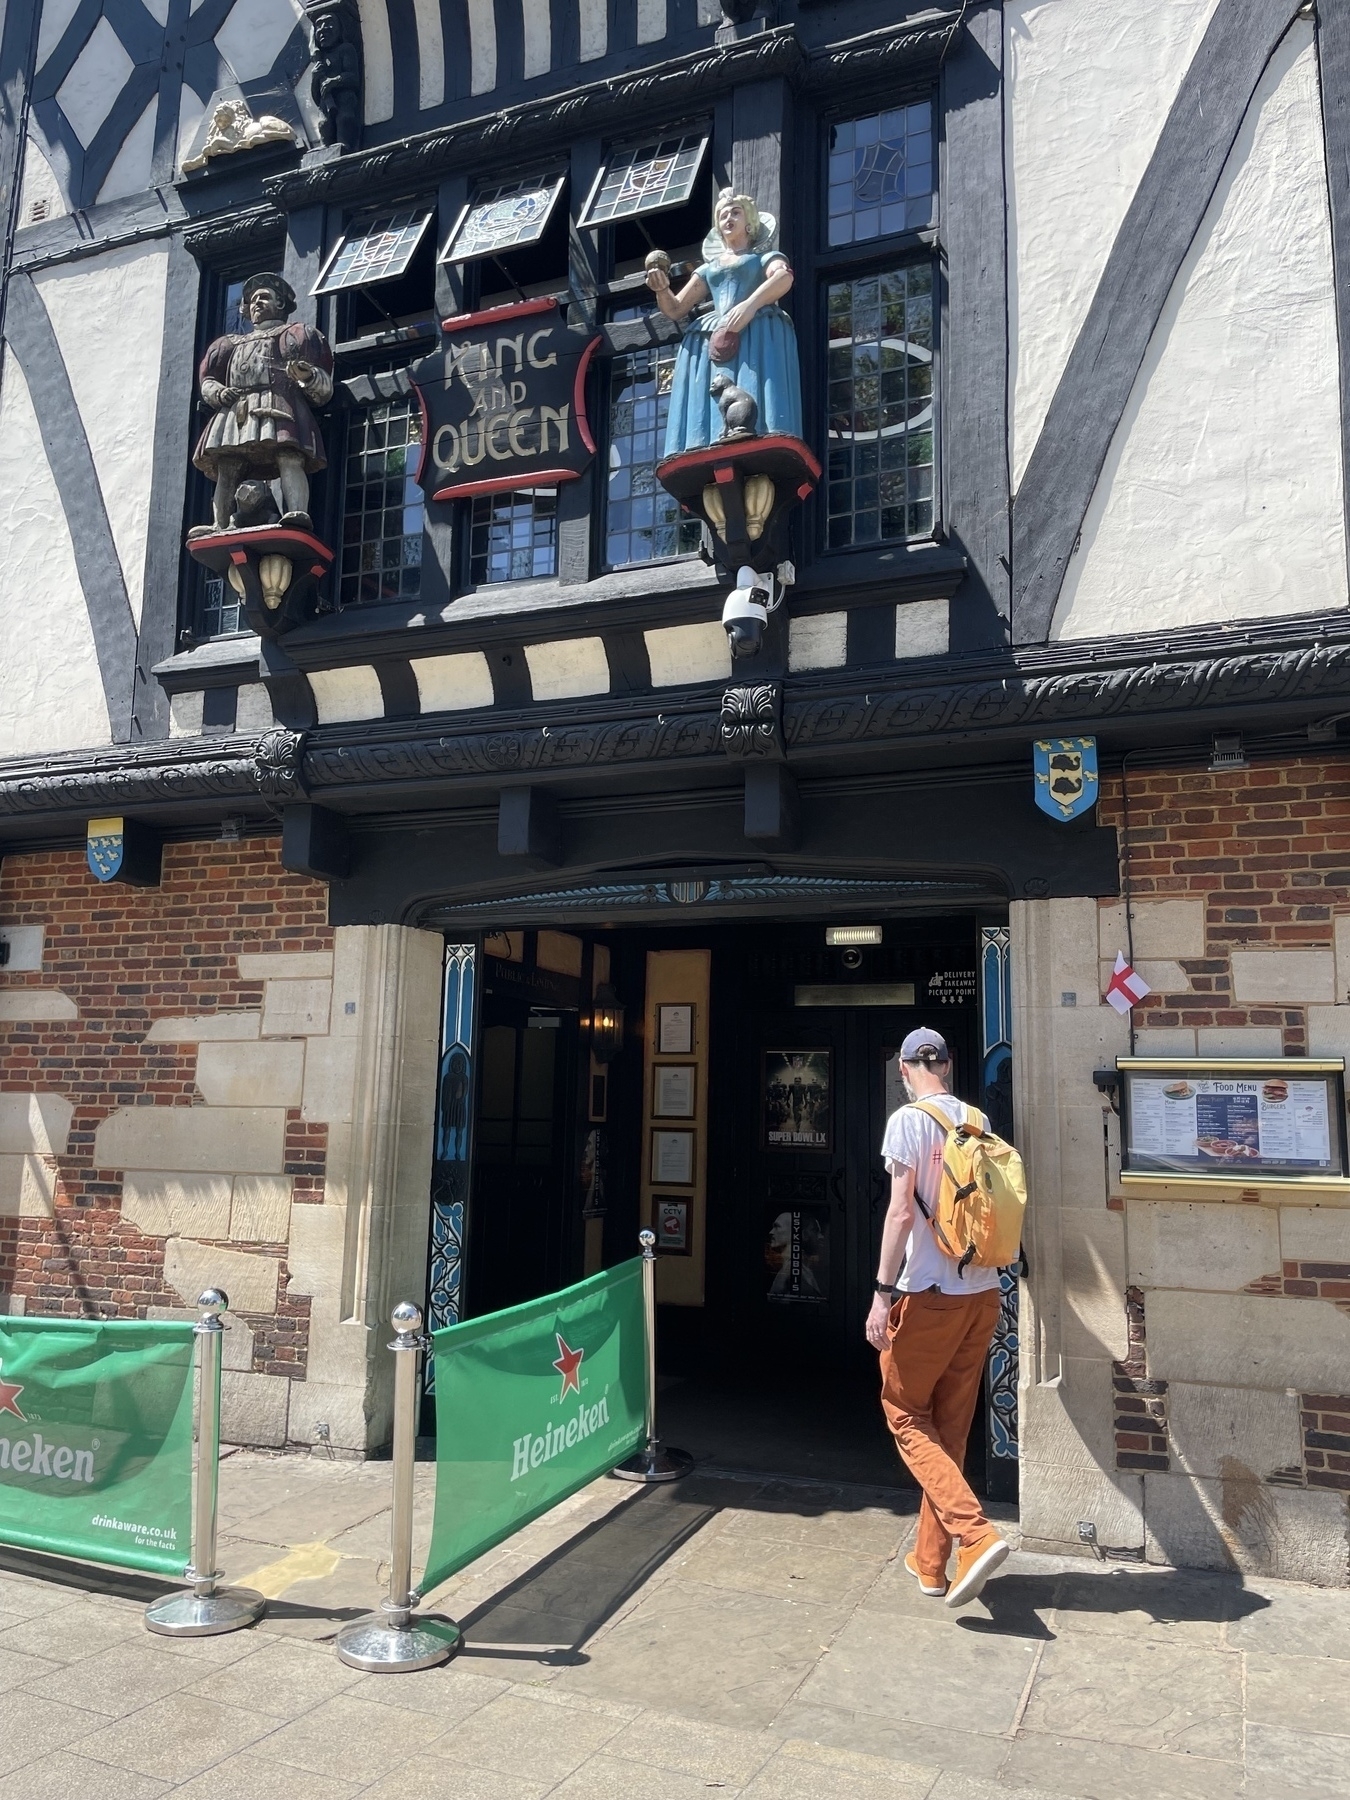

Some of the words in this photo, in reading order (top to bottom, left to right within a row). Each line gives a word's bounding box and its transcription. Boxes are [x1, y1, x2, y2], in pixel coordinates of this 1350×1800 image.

[444, 328, 557, 390] KING
[469, 380, 527, 417] AND
[433, 402, 569, 473] QUEEN
[943, 971, 975, 979] DELIVERY
[944, 979, 976, 987] TAKEAWAY
[955, 988, 976, 996] POINT
[1212, 1081, 1234, 1093] FOOD
[1236, 1082, 1257, 1094] MENU
[1260, 1102, 1287, 1112] BURGERS
[768, 1130, 792, 1142] SUPER
[793, 1131, 815, 1143] BOWL
[815, 1132, 826, 1143] LX
[663, 1207, 683, 1216] CCTV
[793, 1211, 801, 1241] USYK
[792, 1244, 800, 1292] DUBOIS
[510, 1396, 610, 1482] Heineken
[91, 1514, 178, 1540] drinkaware.co.uk
[134, 1535, 145, 1545] for
[146, 1537, 158, 1548] the
[158, 1539, 176, 1551] facts
